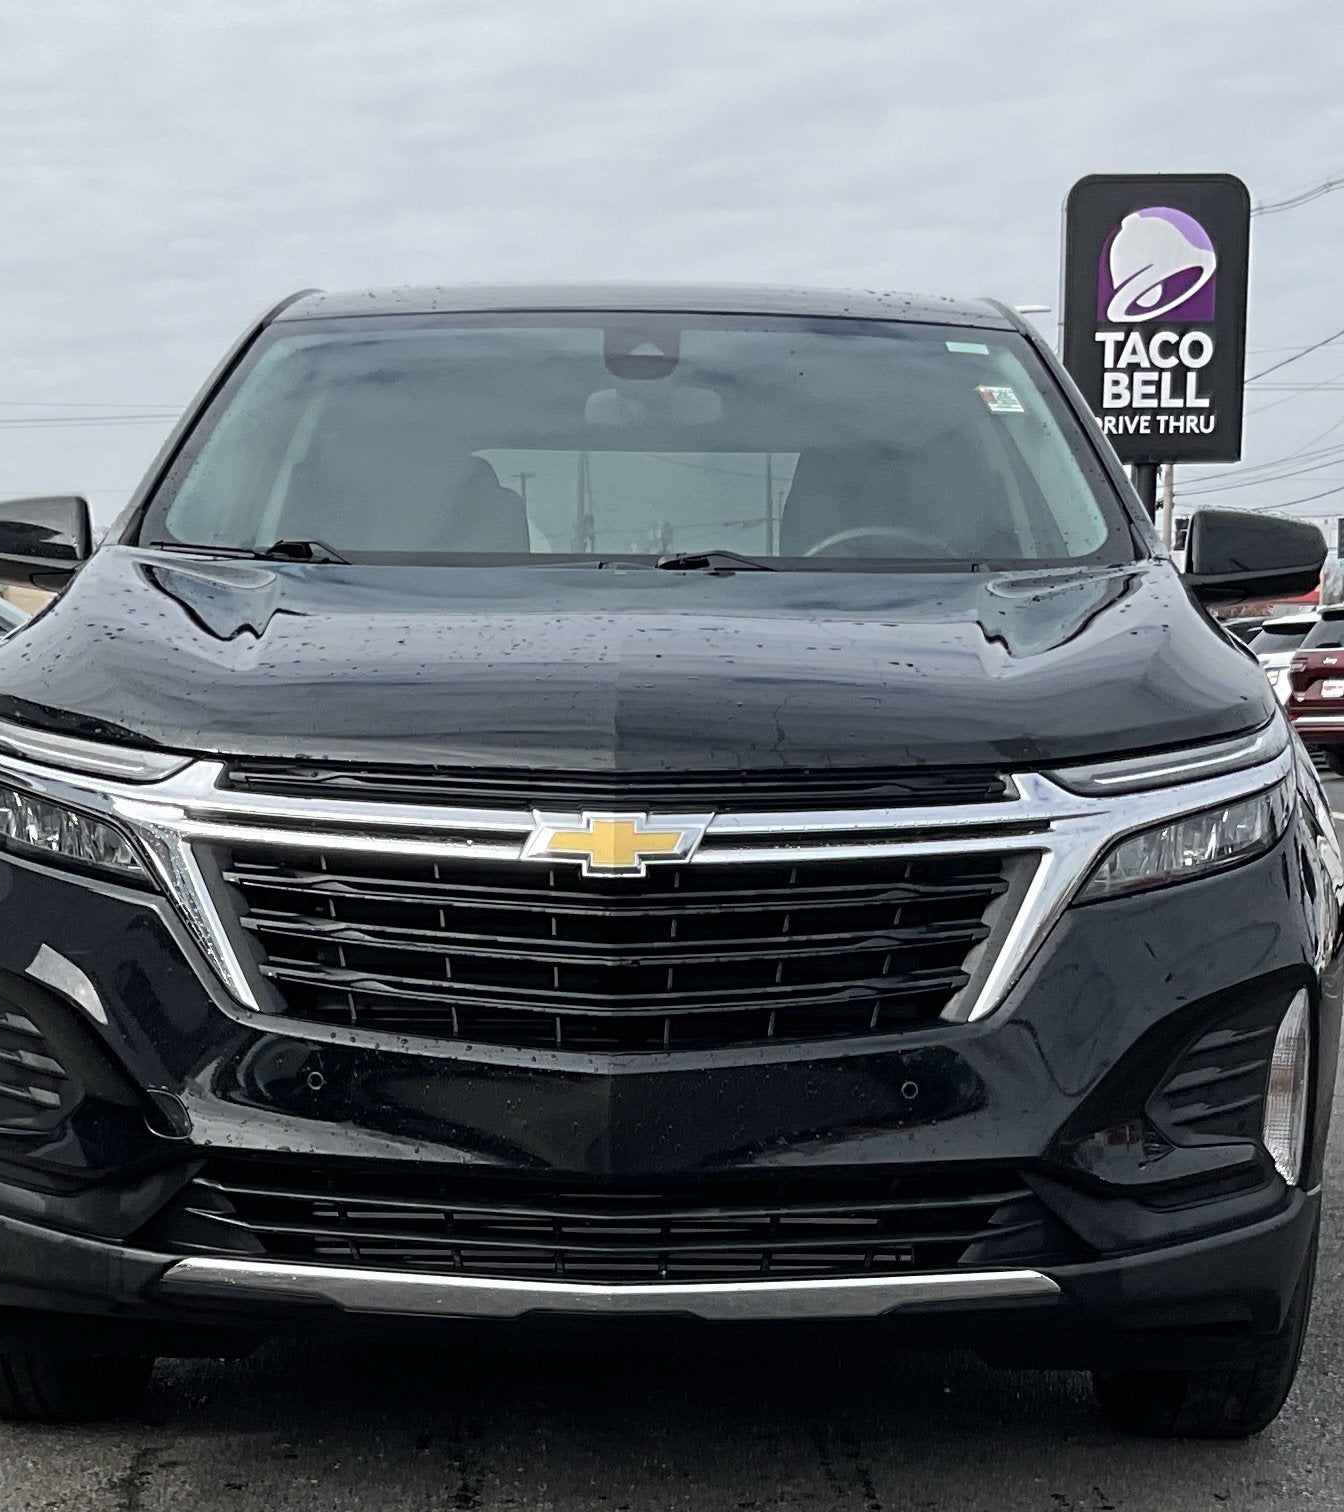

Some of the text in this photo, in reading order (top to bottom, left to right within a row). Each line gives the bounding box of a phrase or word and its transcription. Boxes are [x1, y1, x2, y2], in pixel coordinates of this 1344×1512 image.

[1095, 331, 1213, 369] TACO
[1102, 371, 1210, 409] BELL
[1095, 415, 1215, 435] RIVE THRU
